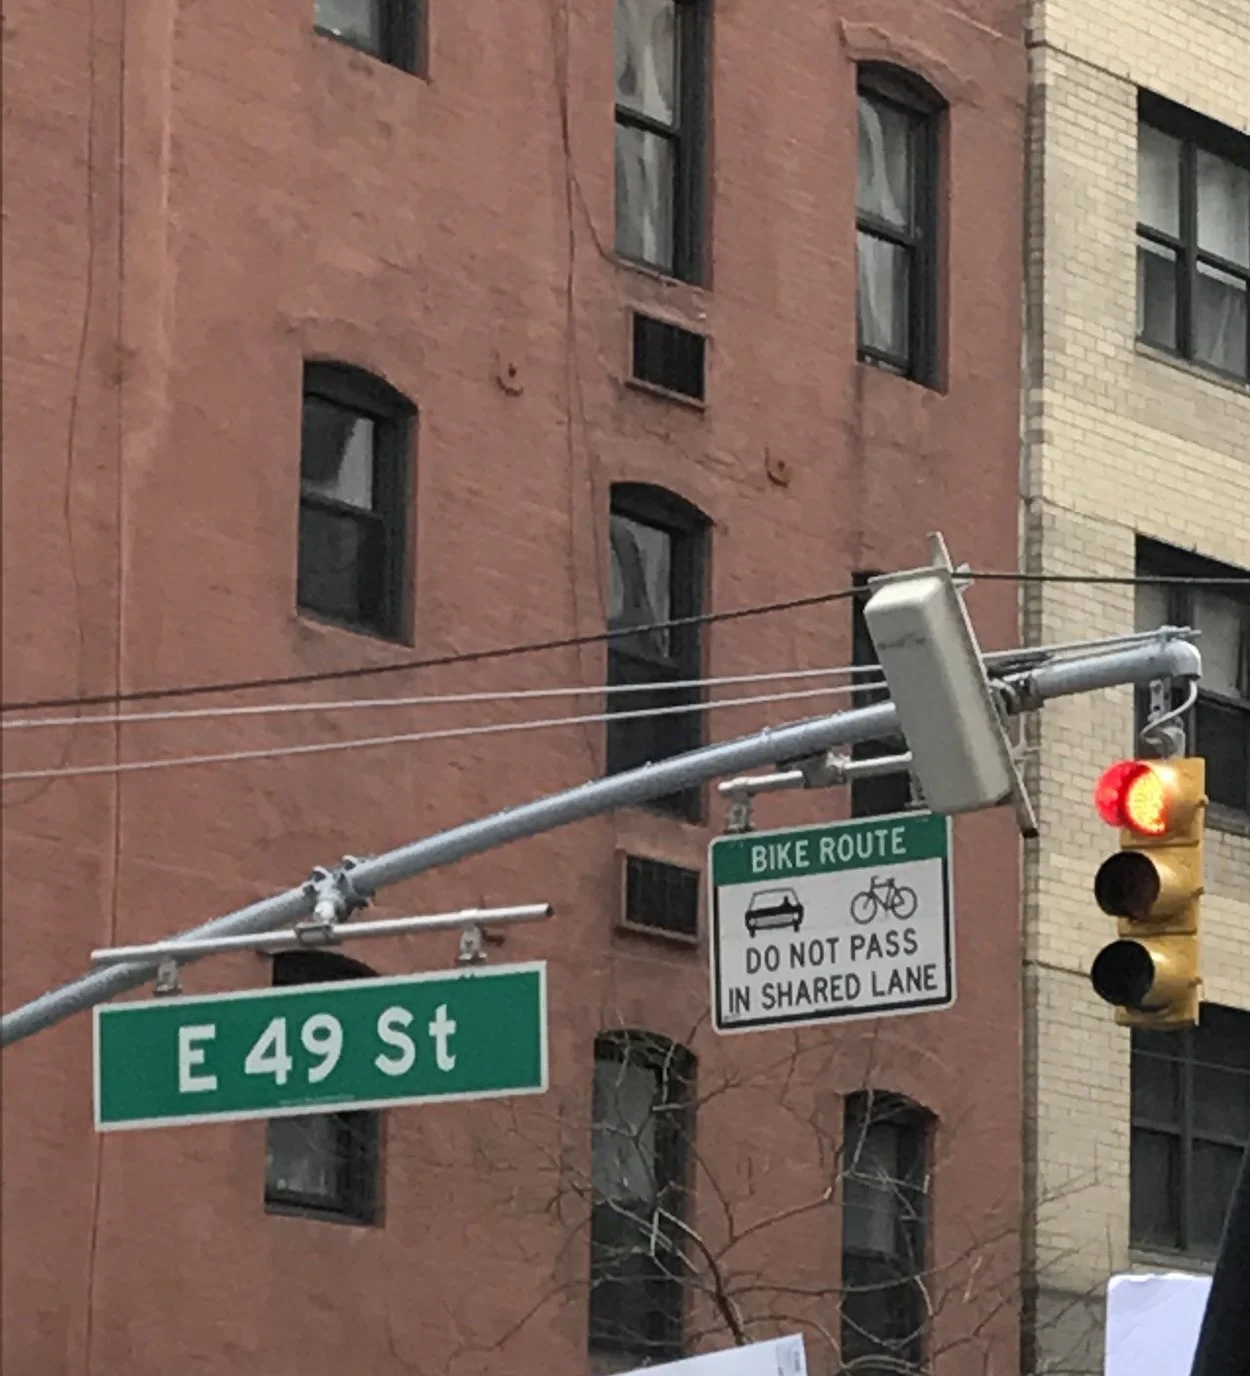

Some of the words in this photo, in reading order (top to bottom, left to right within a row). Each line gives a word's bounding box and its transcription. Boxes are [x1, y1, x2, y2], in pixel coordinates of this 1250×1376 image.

[752, 840, 810, 873] BIKE
[819, 827, 907, 864] ROUTE
[746, 945, 780, 974] DO
[790, 937, 840, 968] NOT
[850, 928, 918, 961] PASS
[729, 986, 750, 1013] IN
[762, 973, 861, 1010] SHARED
[872, 964, 938, 997] LANE
[178, 1023, 218, 1093] E
[244, 1013, 343, 1086] 49
[374, 1003, 457, 1076] St
